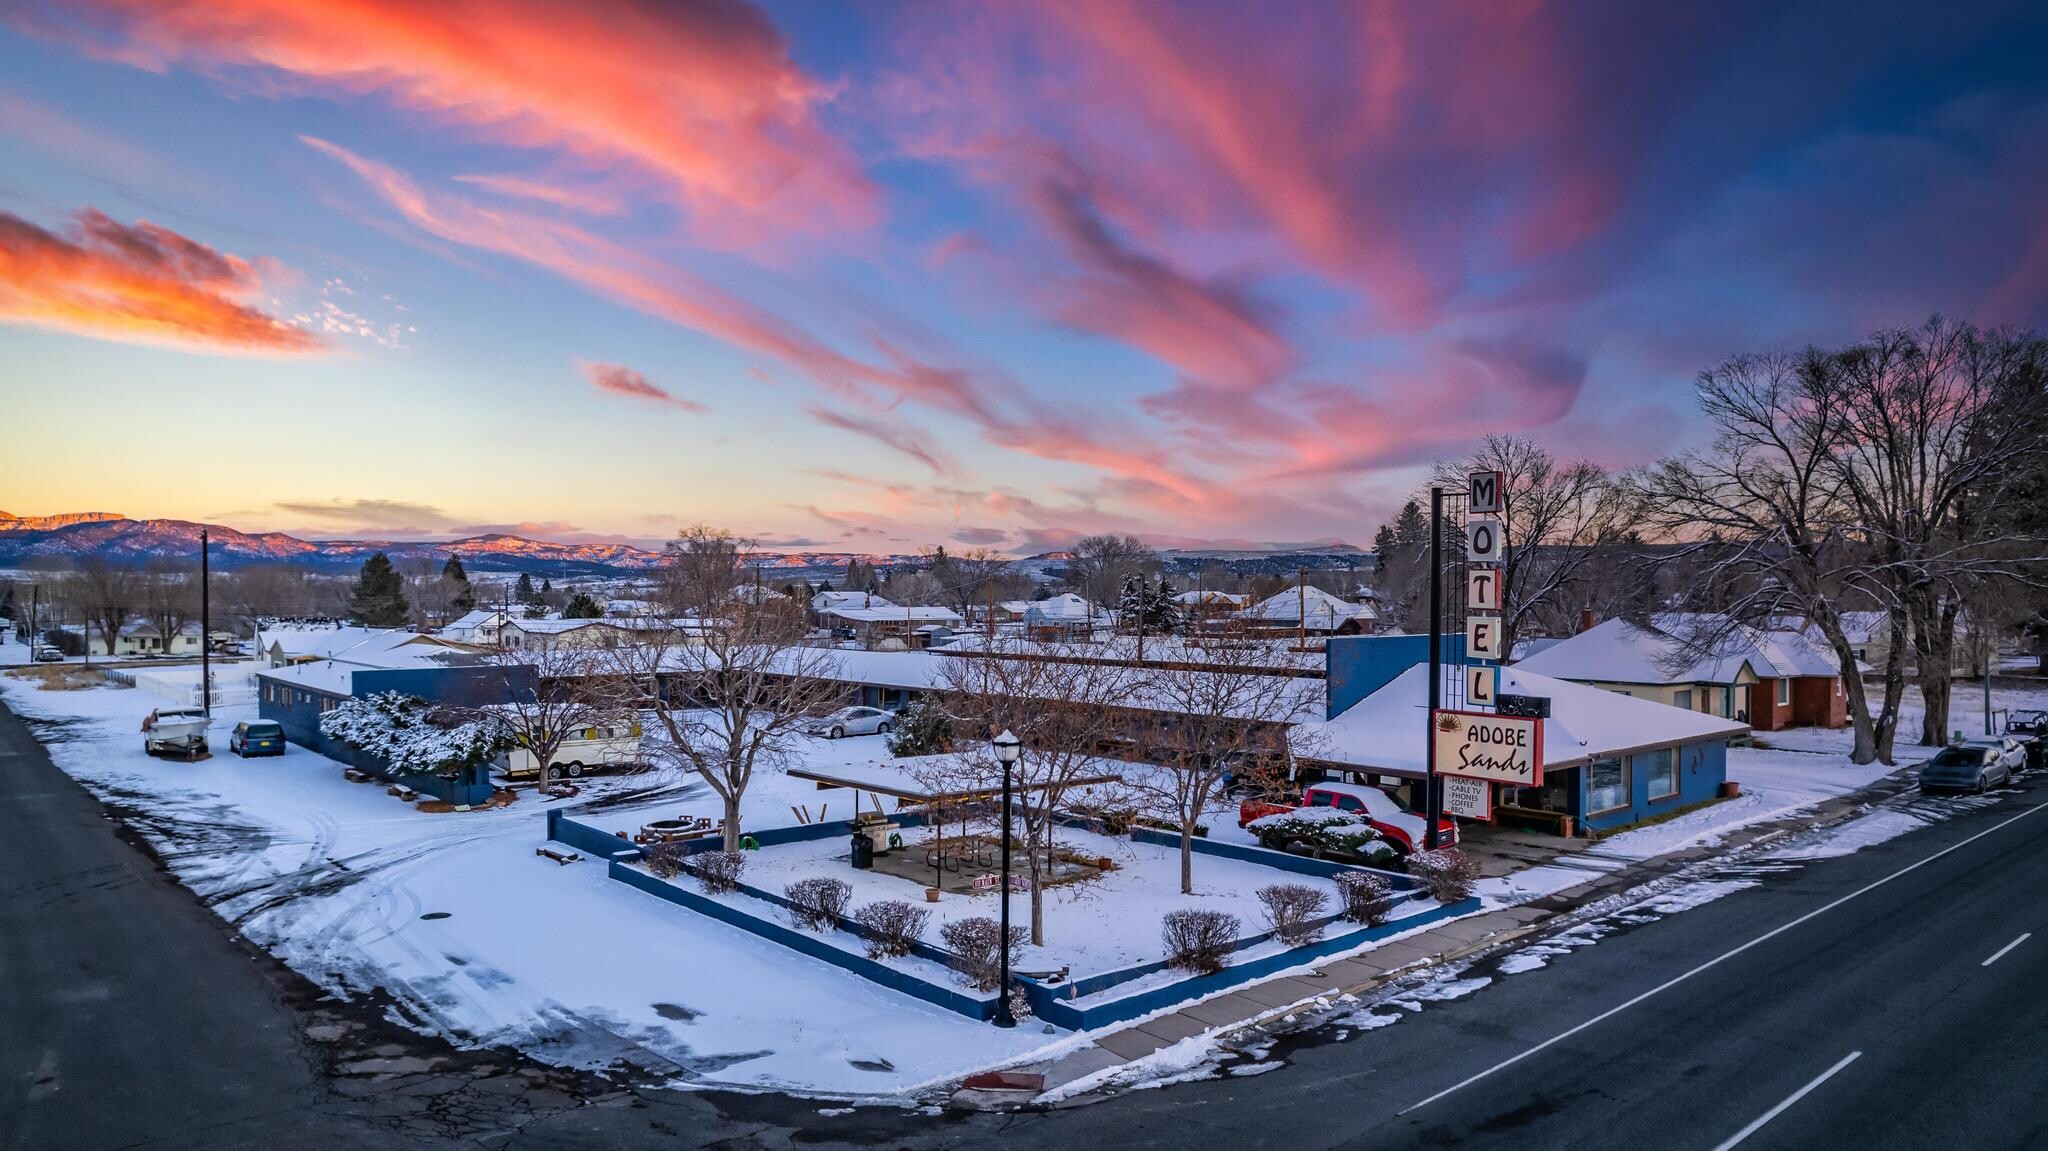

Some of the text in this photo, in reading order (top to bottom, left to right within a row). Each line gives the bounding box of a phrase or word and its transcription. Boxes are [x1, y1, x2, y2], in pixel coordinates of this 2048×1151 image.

[1472, 478, 1493, 700] MOTEL
[1511, 696, 1526, 706] NO
[1468, 725, 1527, 747] ADOBE
[1458, 743, 1530, 775] Sands
[1451, 785, 1482, 795] CABLE TV
[1451, 792, 1479, 802] PHONES
[1451, 799, 1474, 808] COFFEE
[1450, 805, 1464, 814] BBQ
